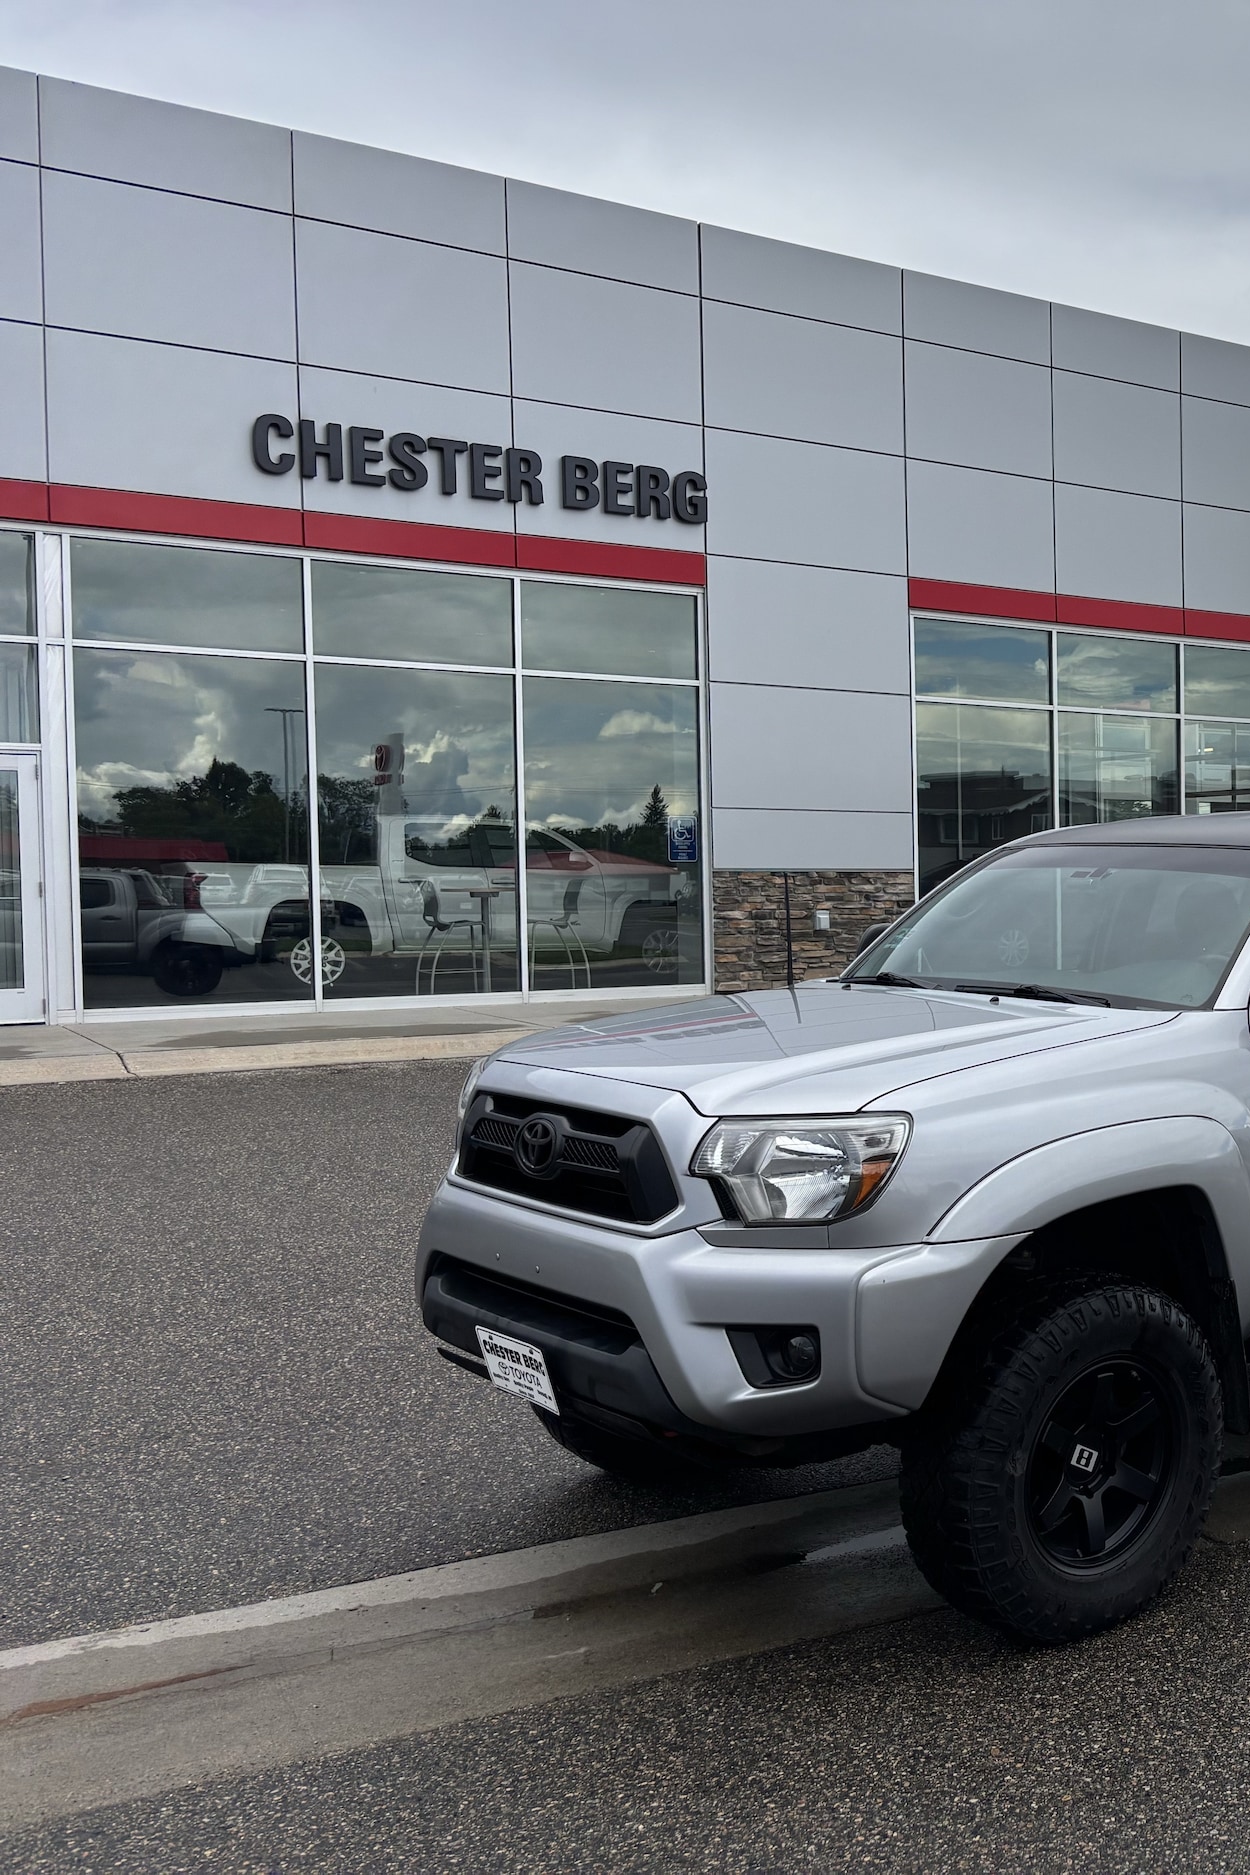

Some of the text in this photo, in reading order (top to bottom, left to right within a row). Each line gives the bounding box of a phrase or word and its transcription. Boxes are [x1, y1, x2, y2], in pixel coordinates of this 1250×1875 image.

[252, 413, 708, 524] CHESTER BERG
[482, 1339, 546, 1377] CHESTER BERG
[508, 1365, 543, 1389] TOYOTA
